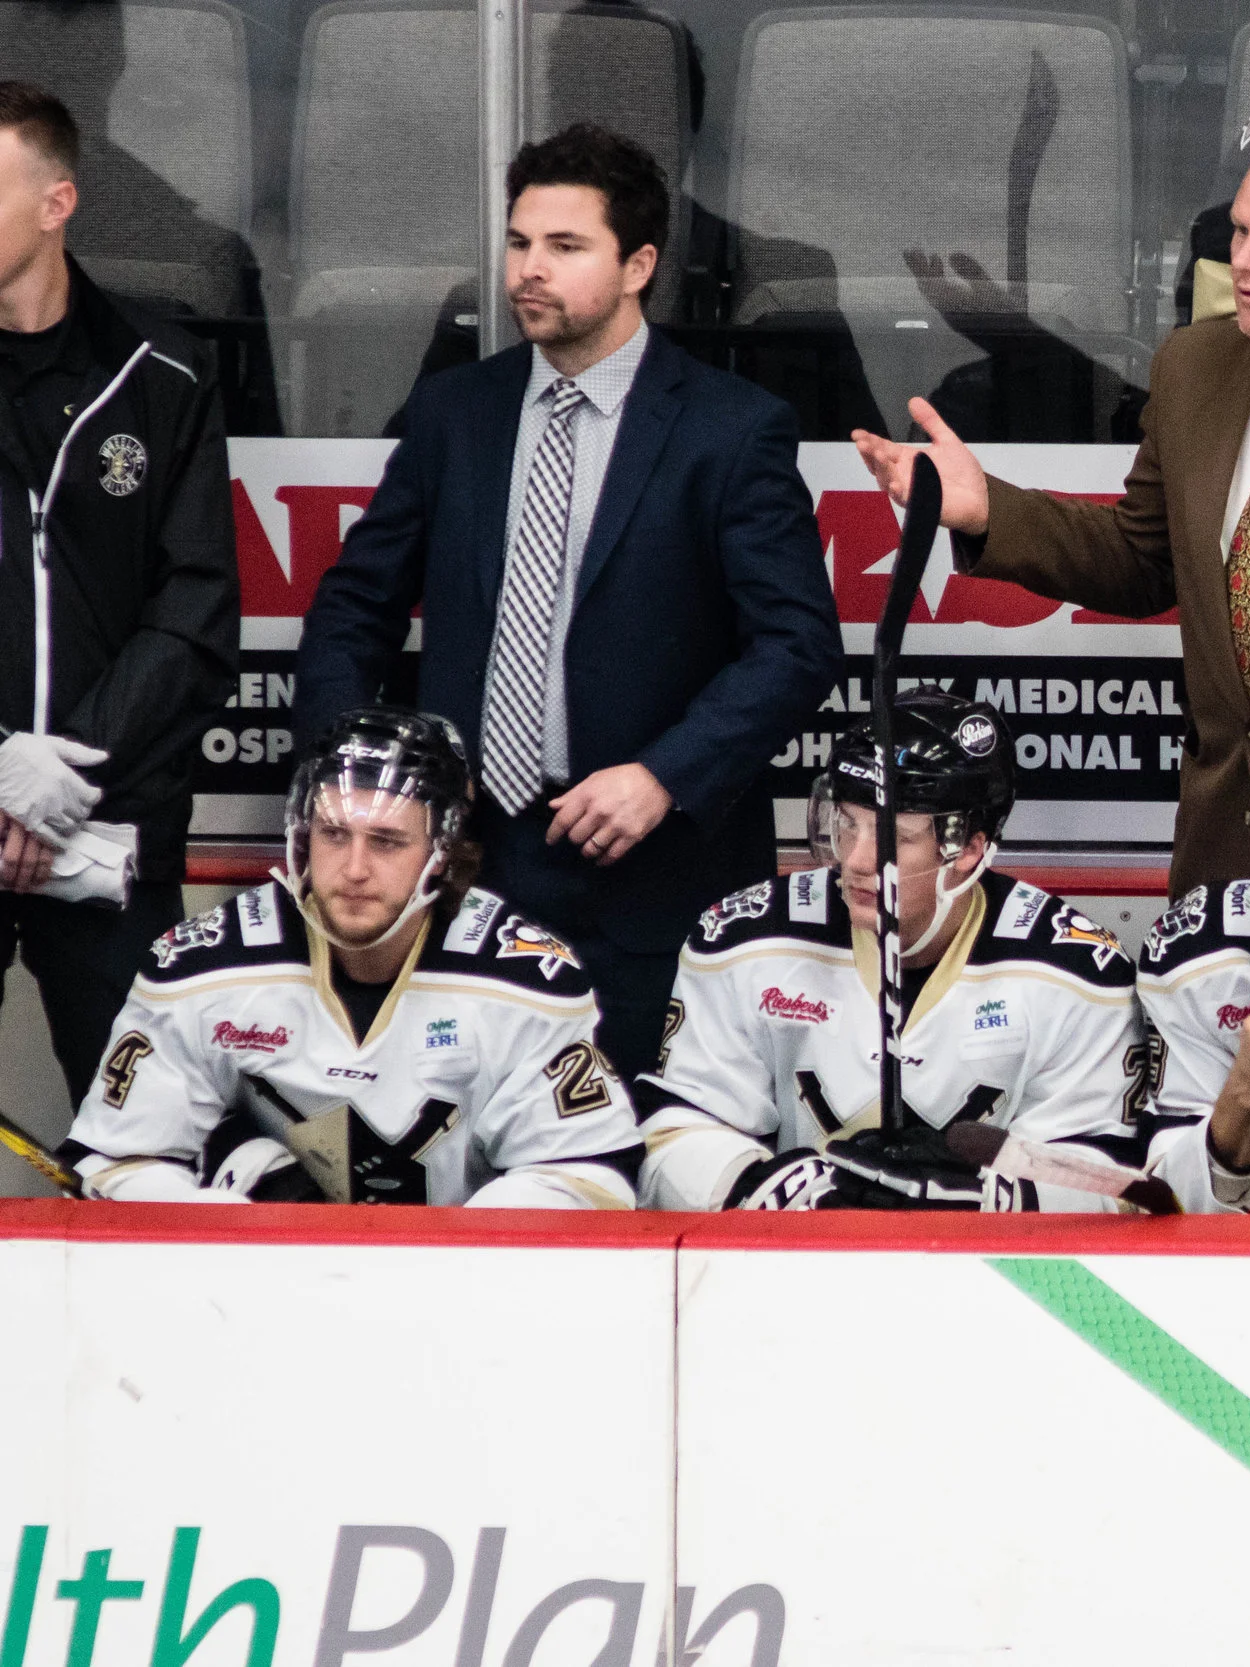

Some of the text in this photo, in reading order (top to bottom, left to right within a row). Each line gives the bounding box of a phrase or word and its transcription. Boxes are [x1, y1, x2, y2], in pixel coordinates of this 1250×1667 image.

[975, 678, 1183, 715] MEDICAL
[326, 1067, 378, 1082] CCM
[542, 1040, 615, 1119] 2
